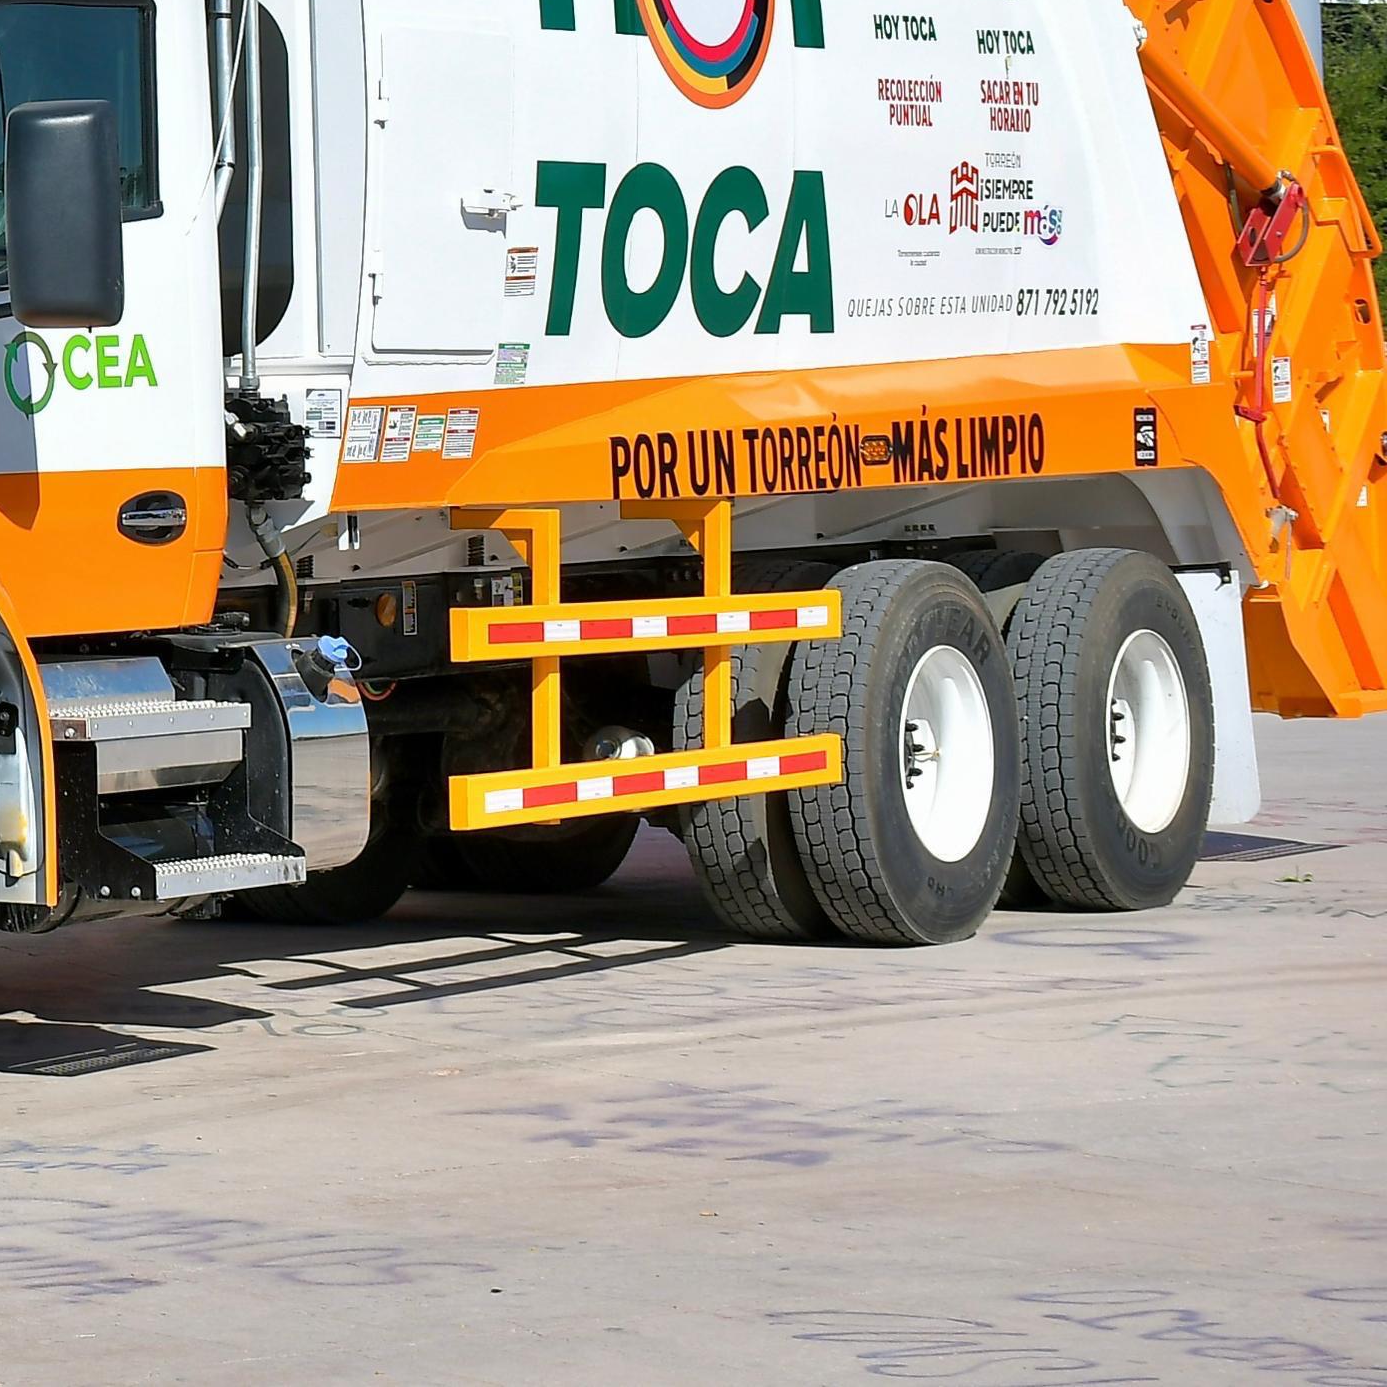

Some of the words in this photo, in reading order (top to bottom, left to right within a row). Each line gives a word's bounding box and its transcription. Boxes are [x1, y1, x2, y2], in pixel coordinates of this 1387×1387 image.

[873, 13, 900, 40] HOY
[902, 15, 938, 41] TOCA
[976, 29, 1001, 54] HOY
[1002, 30, 1036, 55] TOCA
[877, 74, 943, 103] RECOLECCIÓN
[980, 79, 1011, 105] SACAR
[1013, 82, 1024, 106] EN
[1026, 82, 1039, 106] TU
[889, 104, 933, 127] PUNTUAL
[990, 107, 1031, 133] HORARIO
[885, 199, 899, 218] LA
[903, 193, 941, 226] OLA
[535, 160, 835, 339] TOCA
[847, 298, 894, 317] QUEJAS
[897, 296, 936, 317] SOBRE
[940, 295, 967, 315] ESTA
[971, 293, 1013, 314] UNIDAD
[1016, 288, 1040, 316] 871
[1043, 288, 1068, 316] 792
[1069, 287, 1099, 316] 5192
[608, 431, 679, 500] POR
[686, 429, 735, 497] UN
[741, 411, 862, 495] TORREÓN
[891, 405, 949, 483] MÁS
[954, 412, 1045, 479] LIMPIO
